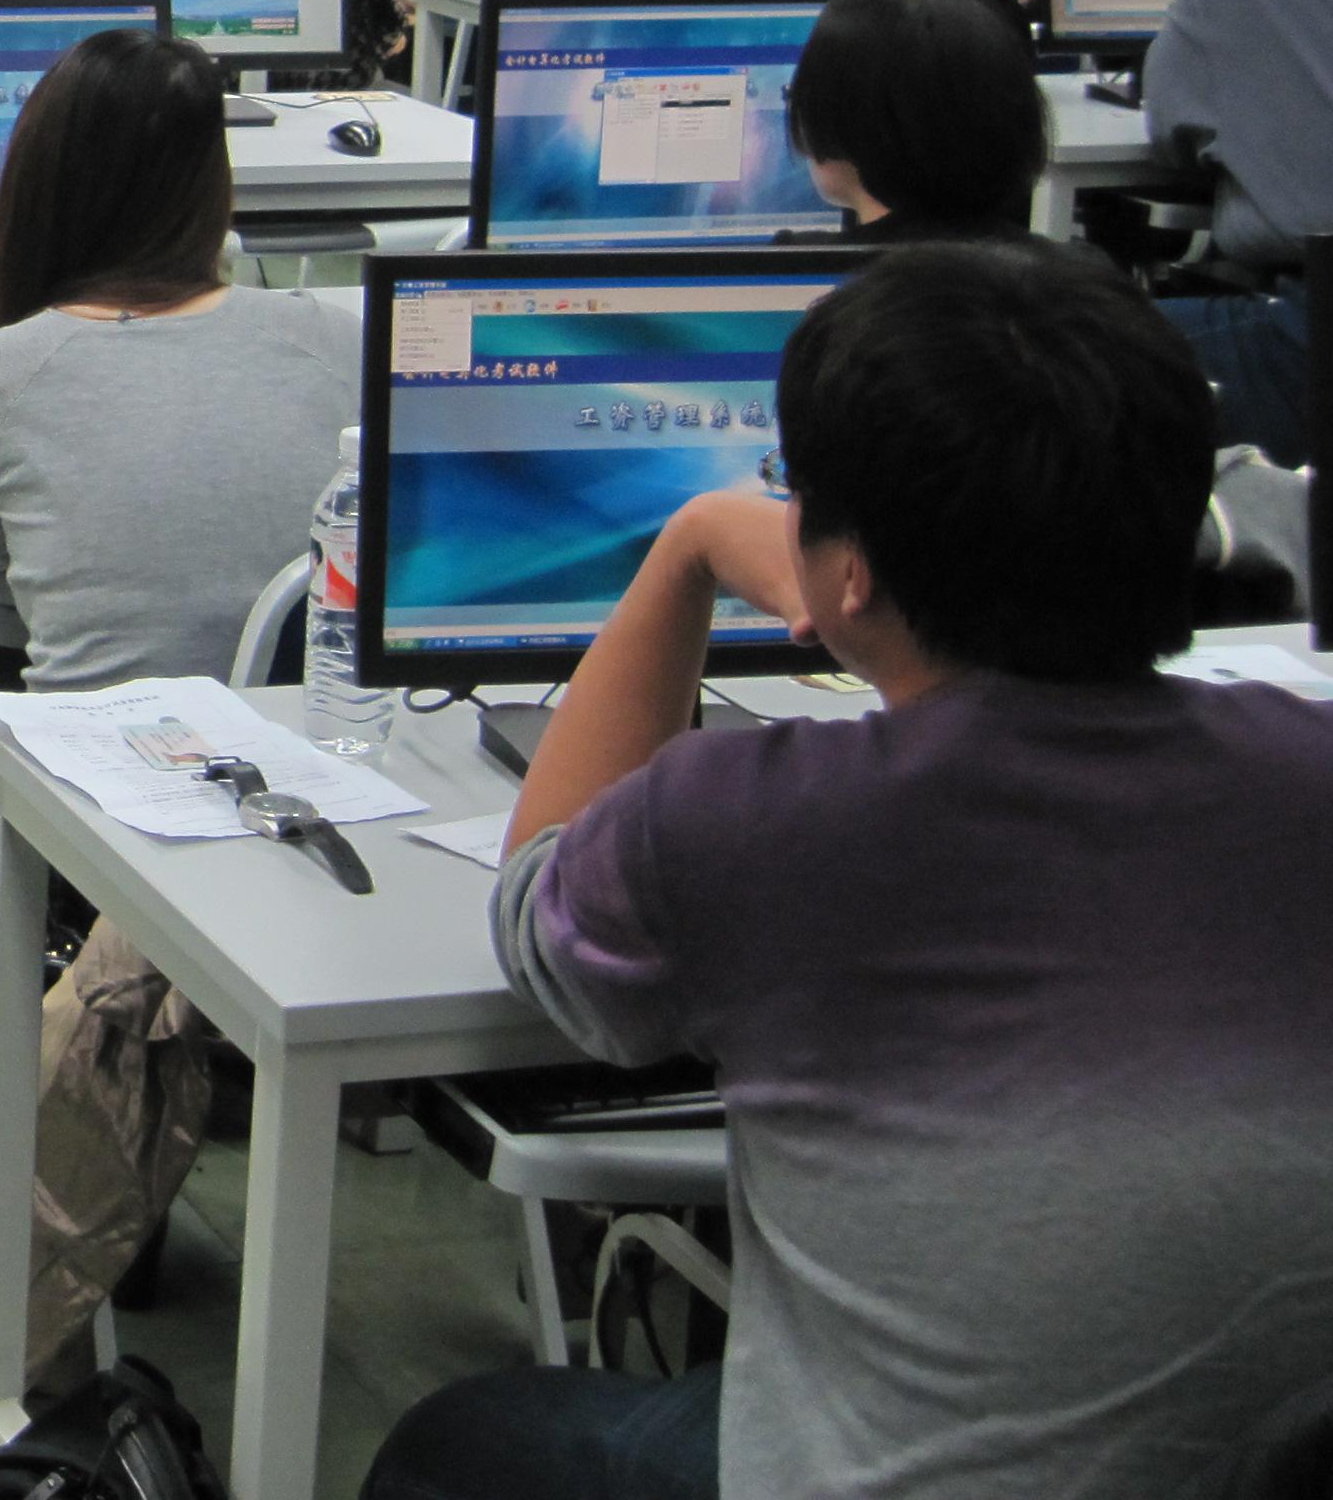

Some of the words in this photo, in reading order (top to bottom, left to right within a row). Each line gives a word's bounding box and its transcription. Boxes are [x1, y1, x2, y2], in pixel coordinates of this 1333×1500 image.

[574, 399, 775, 431] 工资管理系统
